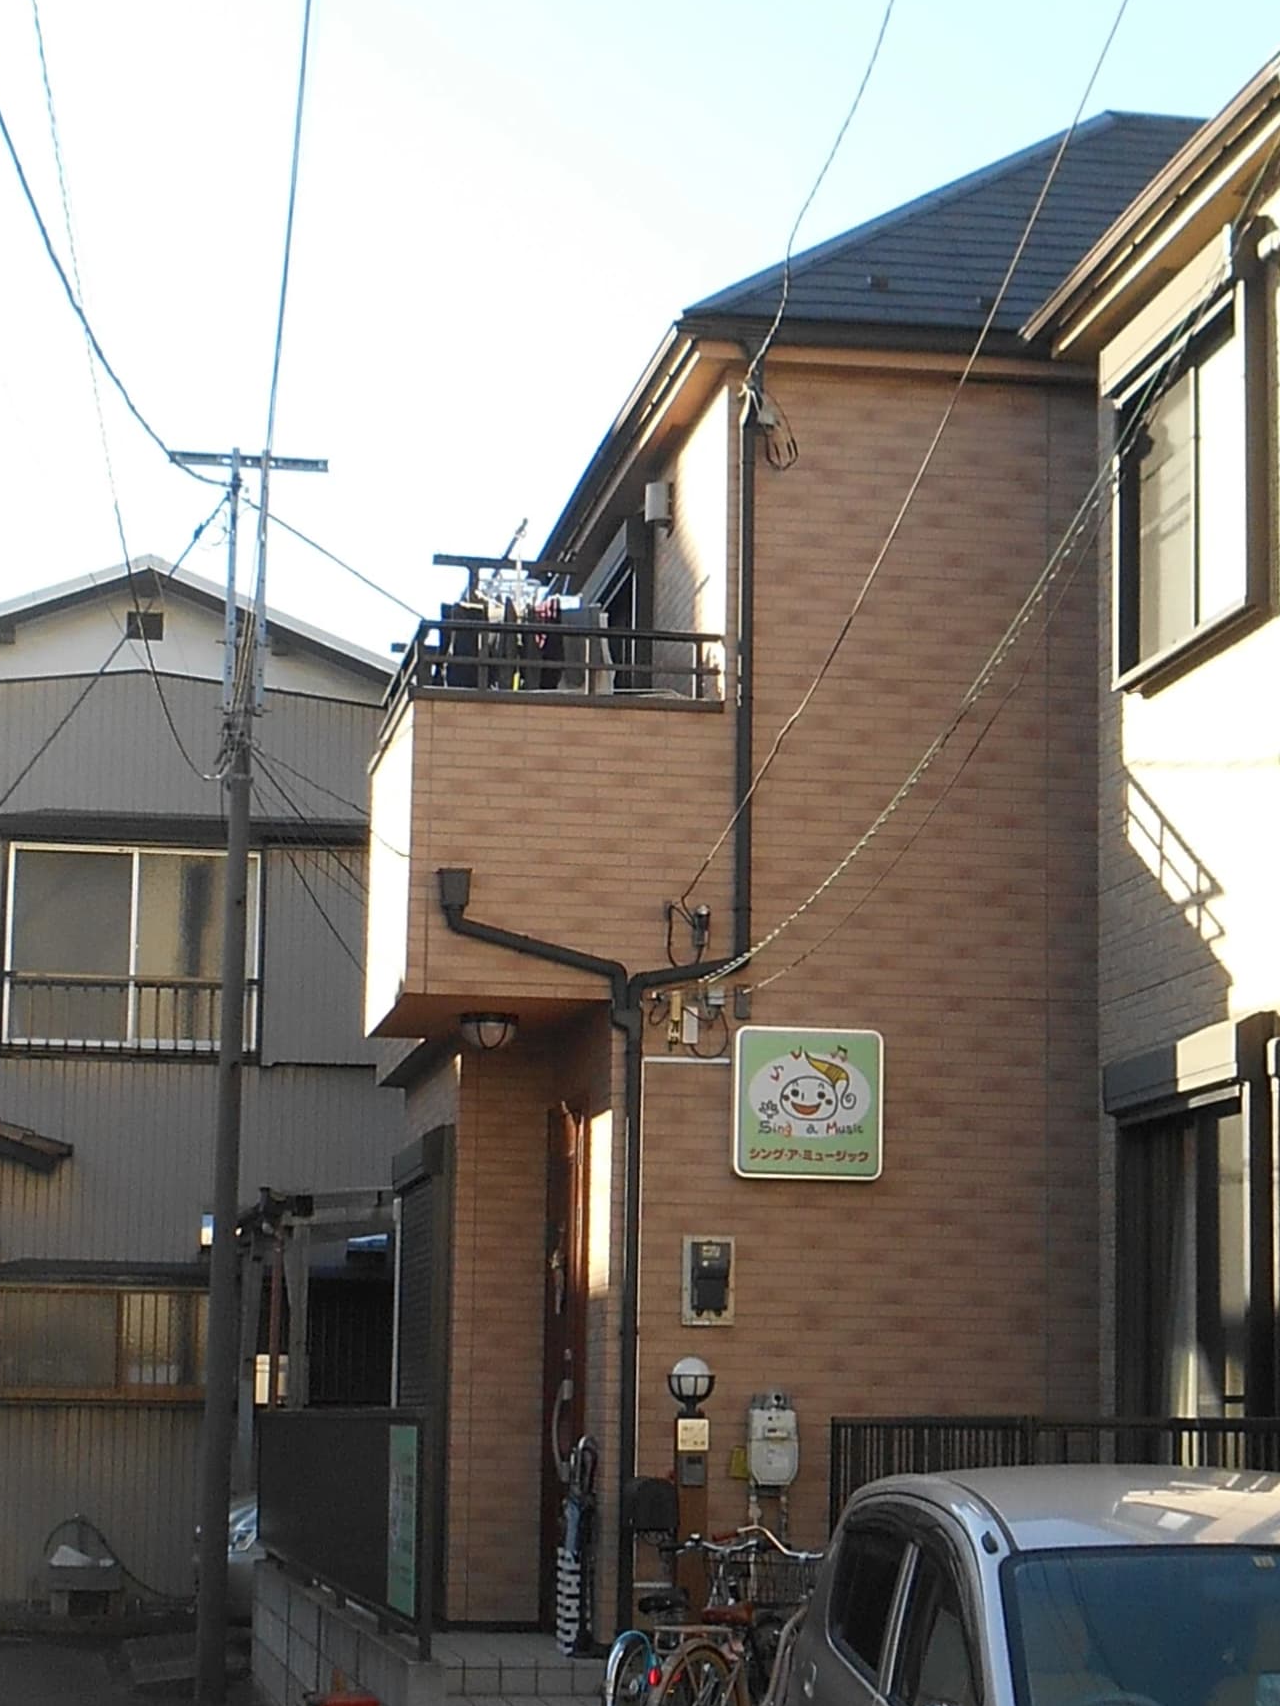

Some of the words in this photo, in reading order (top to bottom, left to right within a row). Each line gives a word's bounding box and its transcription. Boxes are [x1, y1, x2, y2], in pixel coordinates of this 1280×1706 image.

[758, 1121, 792, 1137] Sing
[806, 1123, 818, 1134] a
[826, 1121, 864, 1134] Music
